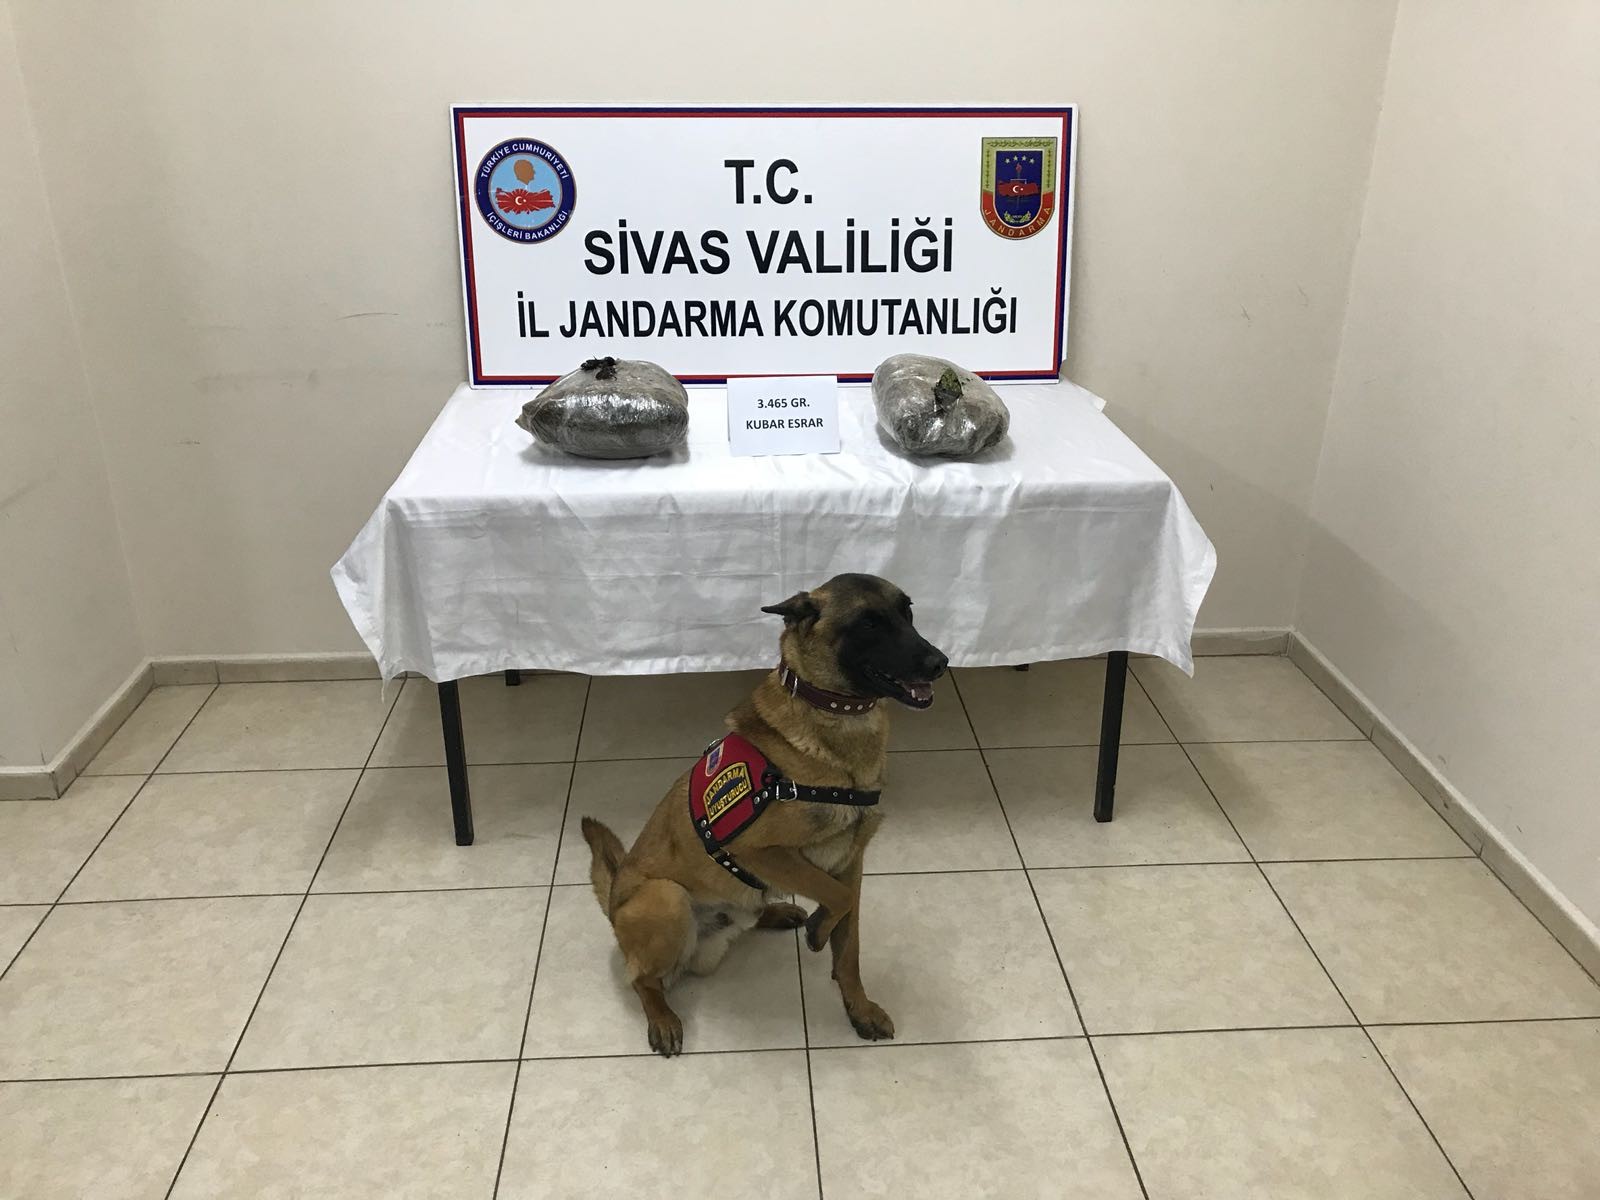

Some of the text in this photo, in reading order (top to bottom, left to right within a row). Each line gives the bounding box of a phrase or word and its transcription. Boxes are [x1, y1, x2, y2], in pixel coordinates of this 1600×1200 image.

[480, 143, 570, 179] TÜRKİYE CUMHURİYETİ
[723, 158, 814, 206] T.C.
[486, 210, 569, 240] İÇİŞLERİ BAKANLIĞI
[984, 207, 1052, 236] JANDARMA
[584, 216, 954, 275] SİVAS VALİLİĞİ
[517, 286, 1018, 338] İL JANDARMA KOMUTANLIĞI
[757, 397, 811, 409] 3.465 GR.
[746, 417, 824, 430] KUBAR ESRAR
[705, 766, 747, 805] JANDARMA
